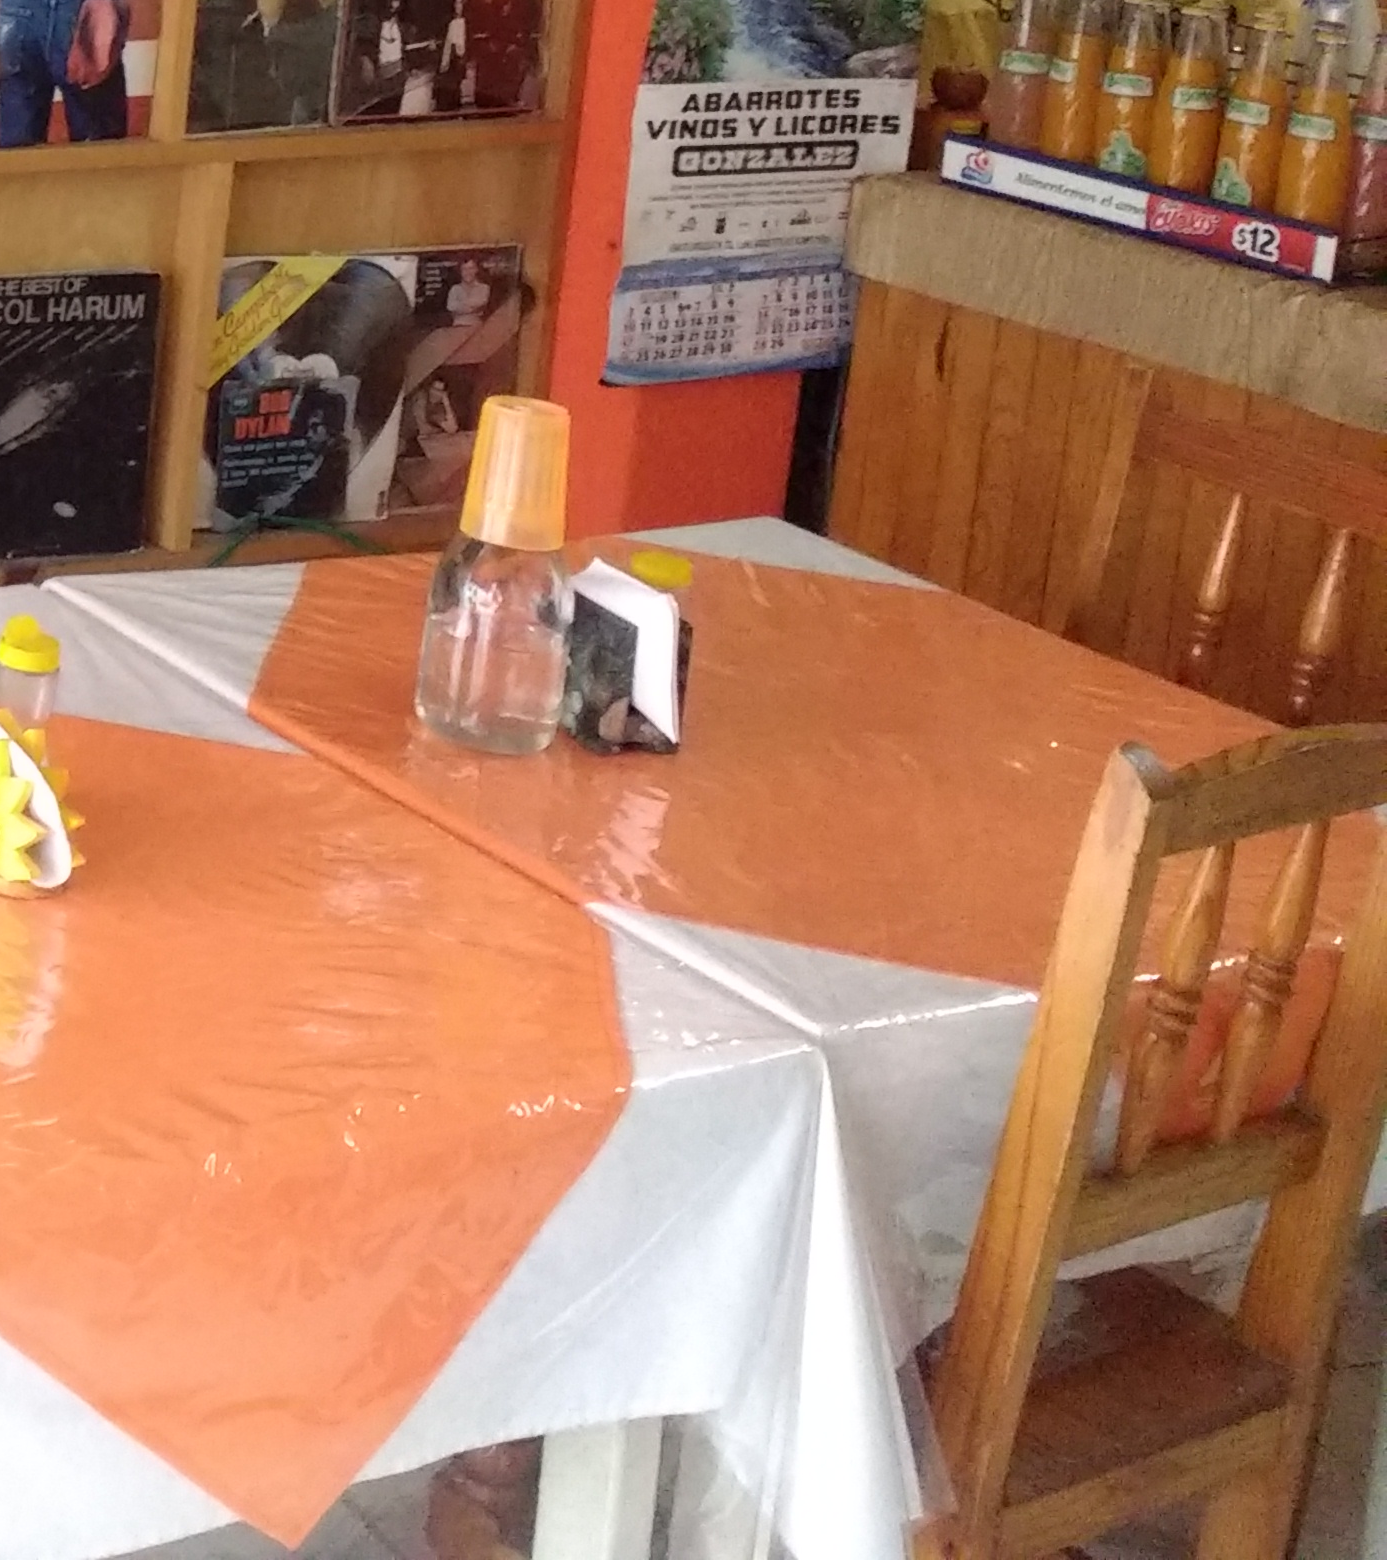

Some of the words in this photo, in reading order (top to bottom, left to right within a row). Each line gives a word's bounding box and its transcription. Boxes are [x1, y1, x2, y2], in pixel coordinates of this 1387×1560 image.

[681, 89, 862, 114] ABARROTES
[646, 118, 737, 140] VINOS
[743, 117, 768, 138] Y
[776, 114, 901, 137] LICORES
[677, 144, 857, 172] GONZALEZ
[1236, 224, 1277, 255] $12
[21, 278, 62, 296] BEST
[64, 277, 90, 293] OF
[47, 294, 147, 323] HARUM
